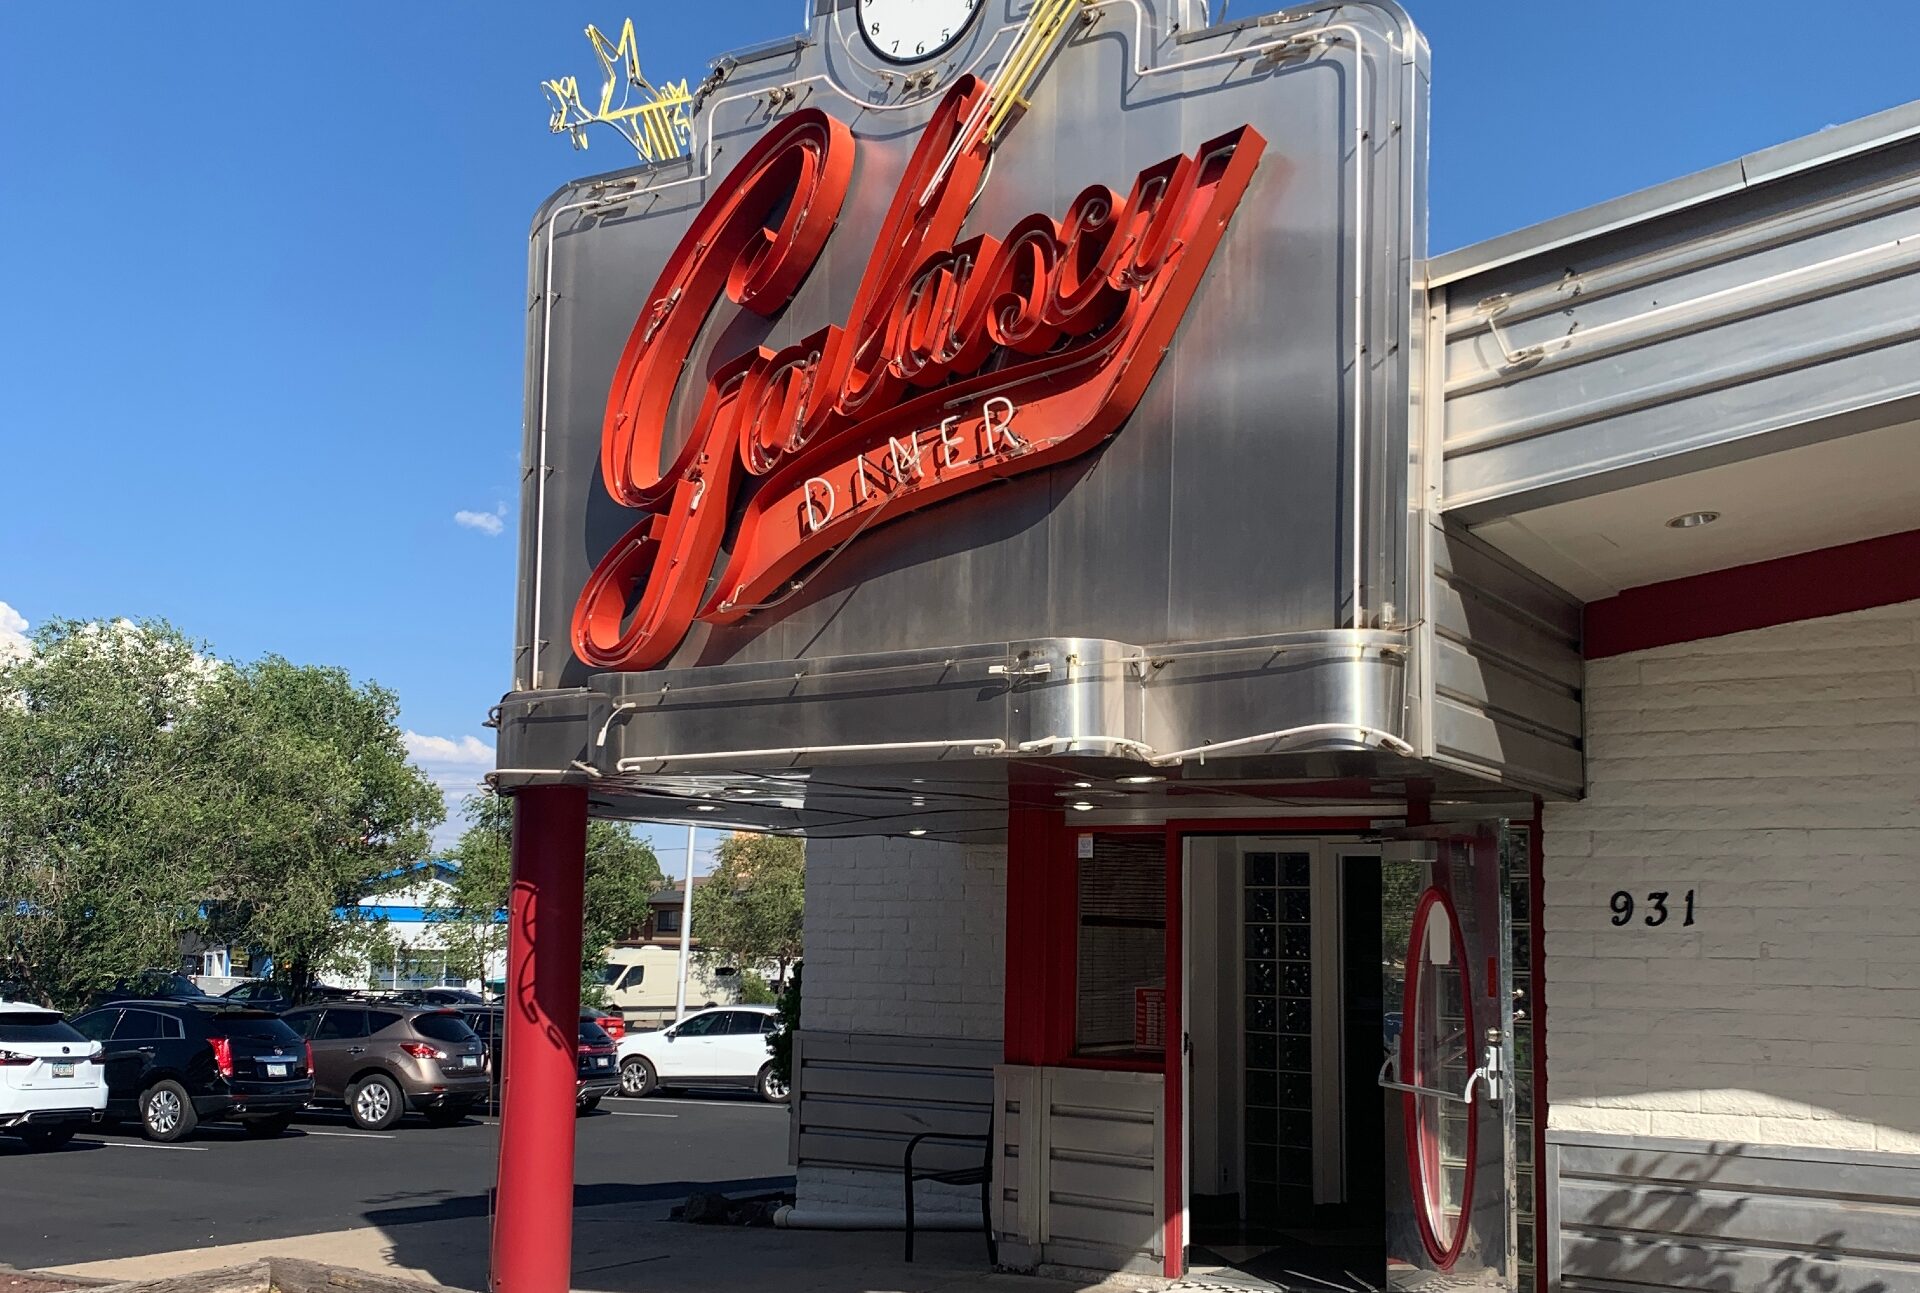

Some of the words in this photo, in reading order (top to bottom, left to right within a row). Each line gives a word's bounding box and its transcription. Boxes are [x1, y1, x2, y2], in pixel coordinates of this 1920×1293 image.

[871, 22, 880, 36] 8
[941, 28, 950, 42] 5
[892, 40, 900, 53] 7
[915, 41, 925, 55] 6
[570, 74, 1268, 671] Galaxy
[803, 396, 1032, 532] DINER
[1610, 889, 1695, 927] 931
